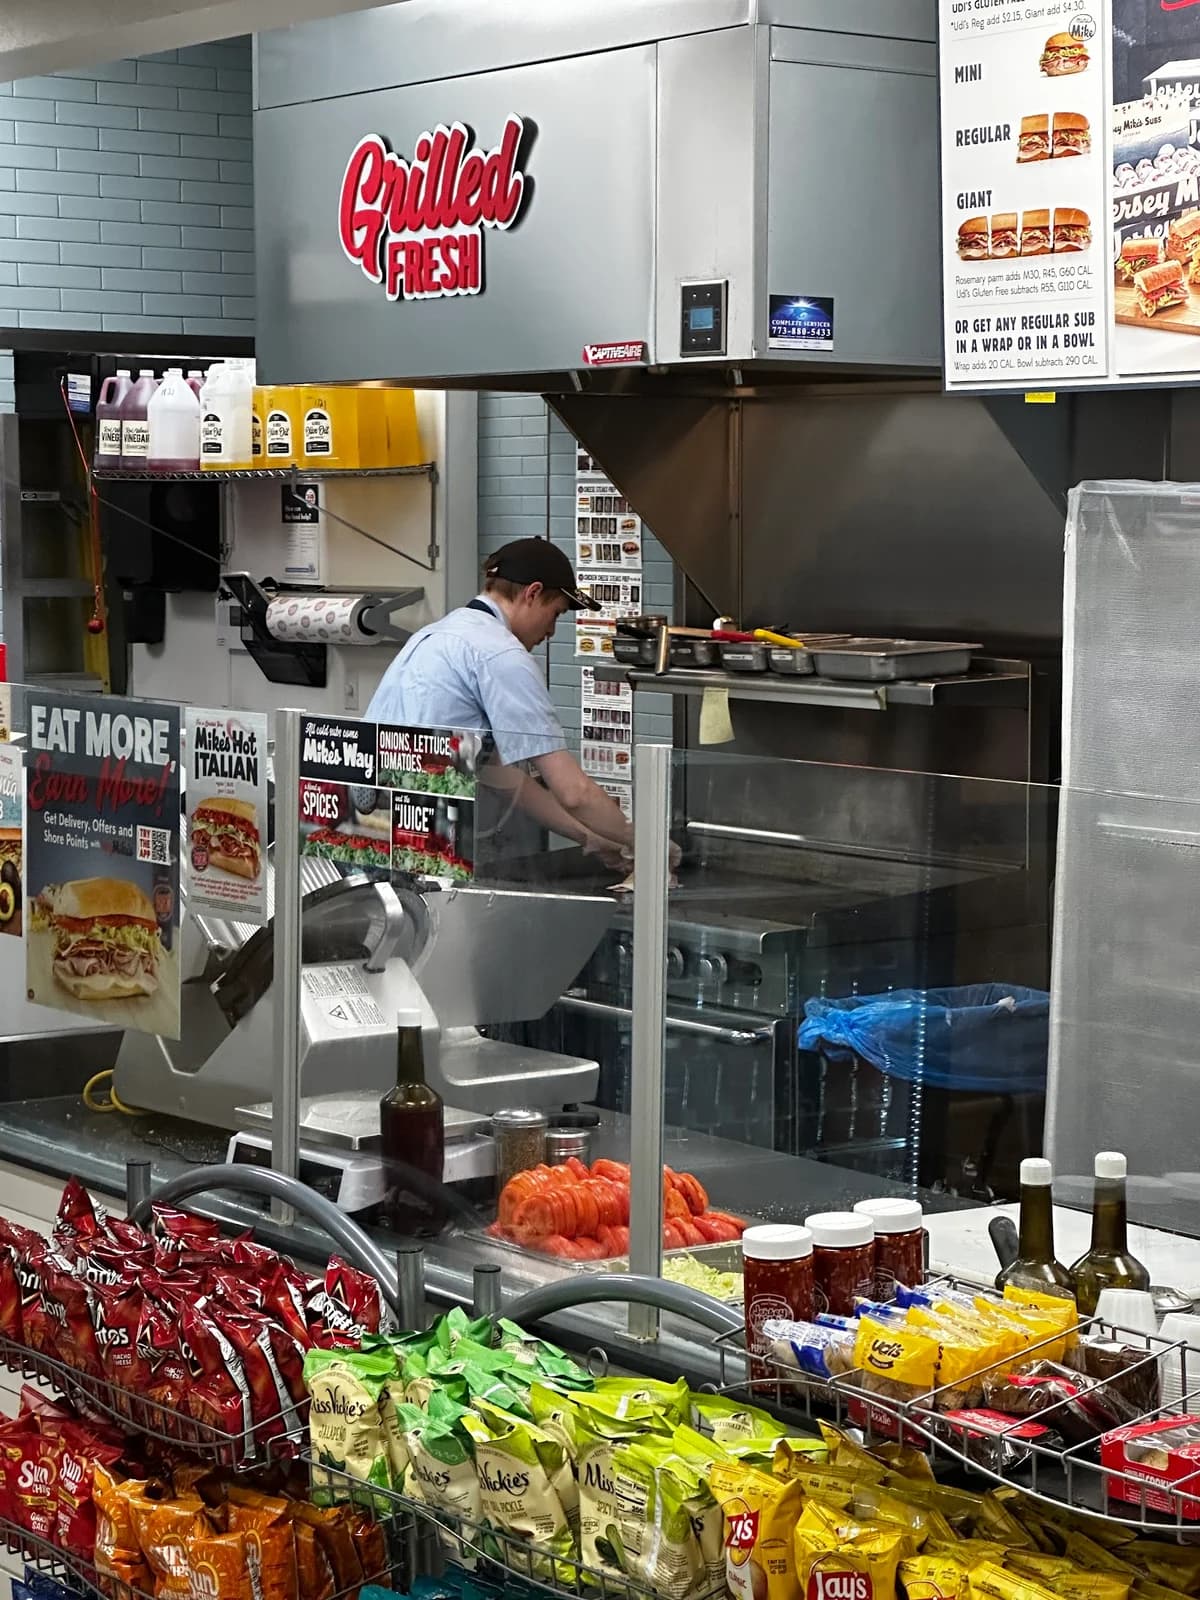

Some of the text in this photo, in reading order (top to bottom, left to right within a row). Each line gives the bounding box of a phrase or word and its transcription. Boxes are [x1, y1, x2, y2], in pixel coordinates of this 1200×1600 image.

[952, 1, 972, 13] UDI'S
[971, 18, 985, 30] Reg
[986, 14, 1000, 26] add
[1002, 10, 1023, 23] $2.15,
[1025, 7, 1045, 19] Giant
[1047, 5, 1060, 15] add
[1071, 24, 1094, 38] Mike
[954, 63, 982, 84] MINI
[955, 124, 1011, 147] REGULAR
[1123, 117, 1143, 132] Mike's
[339, 115, 523, 282] Grilled
[957, 190, 992, 210] GIANT
[1113, 191, 1170, 224] ersey
[387, 233, 480, 296] FRESH
[955, 275, 985, 286] Rosemary
[1005, 270, 1021, 281] adds
[1023, 269, 1041, 280] M30,
[1042, 267, 1058, 279] R45,
[972, 287, 993, 298] Gluten
[995, 286, 1009, 296] Free
[1010, 284, 1038, 295] subtracts
[771, 319, 802, 327] COMPLETE
[955, 311, 1095, 334] OR GET ANY REGULAR SUB
[956, 332, 1095, 354] IN A WRAP OR IN A BOWL
[954, 360, 970, 372] Wrap
[971, 360, 987, 370] adds
[988, 359, 998, 369] 20
[1017, 357, 1034, 368] Bowl
[1035, 356, 1063, 367] subtracts
[1065, 355, 1080, 366] 290
[102, 431, 121, 442] VINEG
[31, 705, 177, 774] EAT MORE,
[195, 726, 258, 757] Mike's Hot
[316, 724, 329, 737] cold
[342, 729, 359, 739] come
[379, 730, 453, 758] ONIONS, LETTUCE,
[194, 751, 259, 787] ITALIAN
[303, 738, 374, 779] Mike's Way
[28, 752, 89, 810] Earn
[95, 755, 172, 818] More!
[303, 790, 339, 819] SPICES
[43, 811, 134, 838] Get Delivery, Offers and
[43, 830, 65, 846] Shore
[66, 833, 89, 849] Points
[139, 838, 151, 848] THE
[116, 1358, 133, 1366] HEESE
[326, 1384, 368, 1425] Vickie's
[17, 1460, 49, 1488] Sun
[60, 1452, 82, 1483] Sun
[478, 1461, 530, 1497] Vickie's
[584, 1462, 615, 1495] Miss
